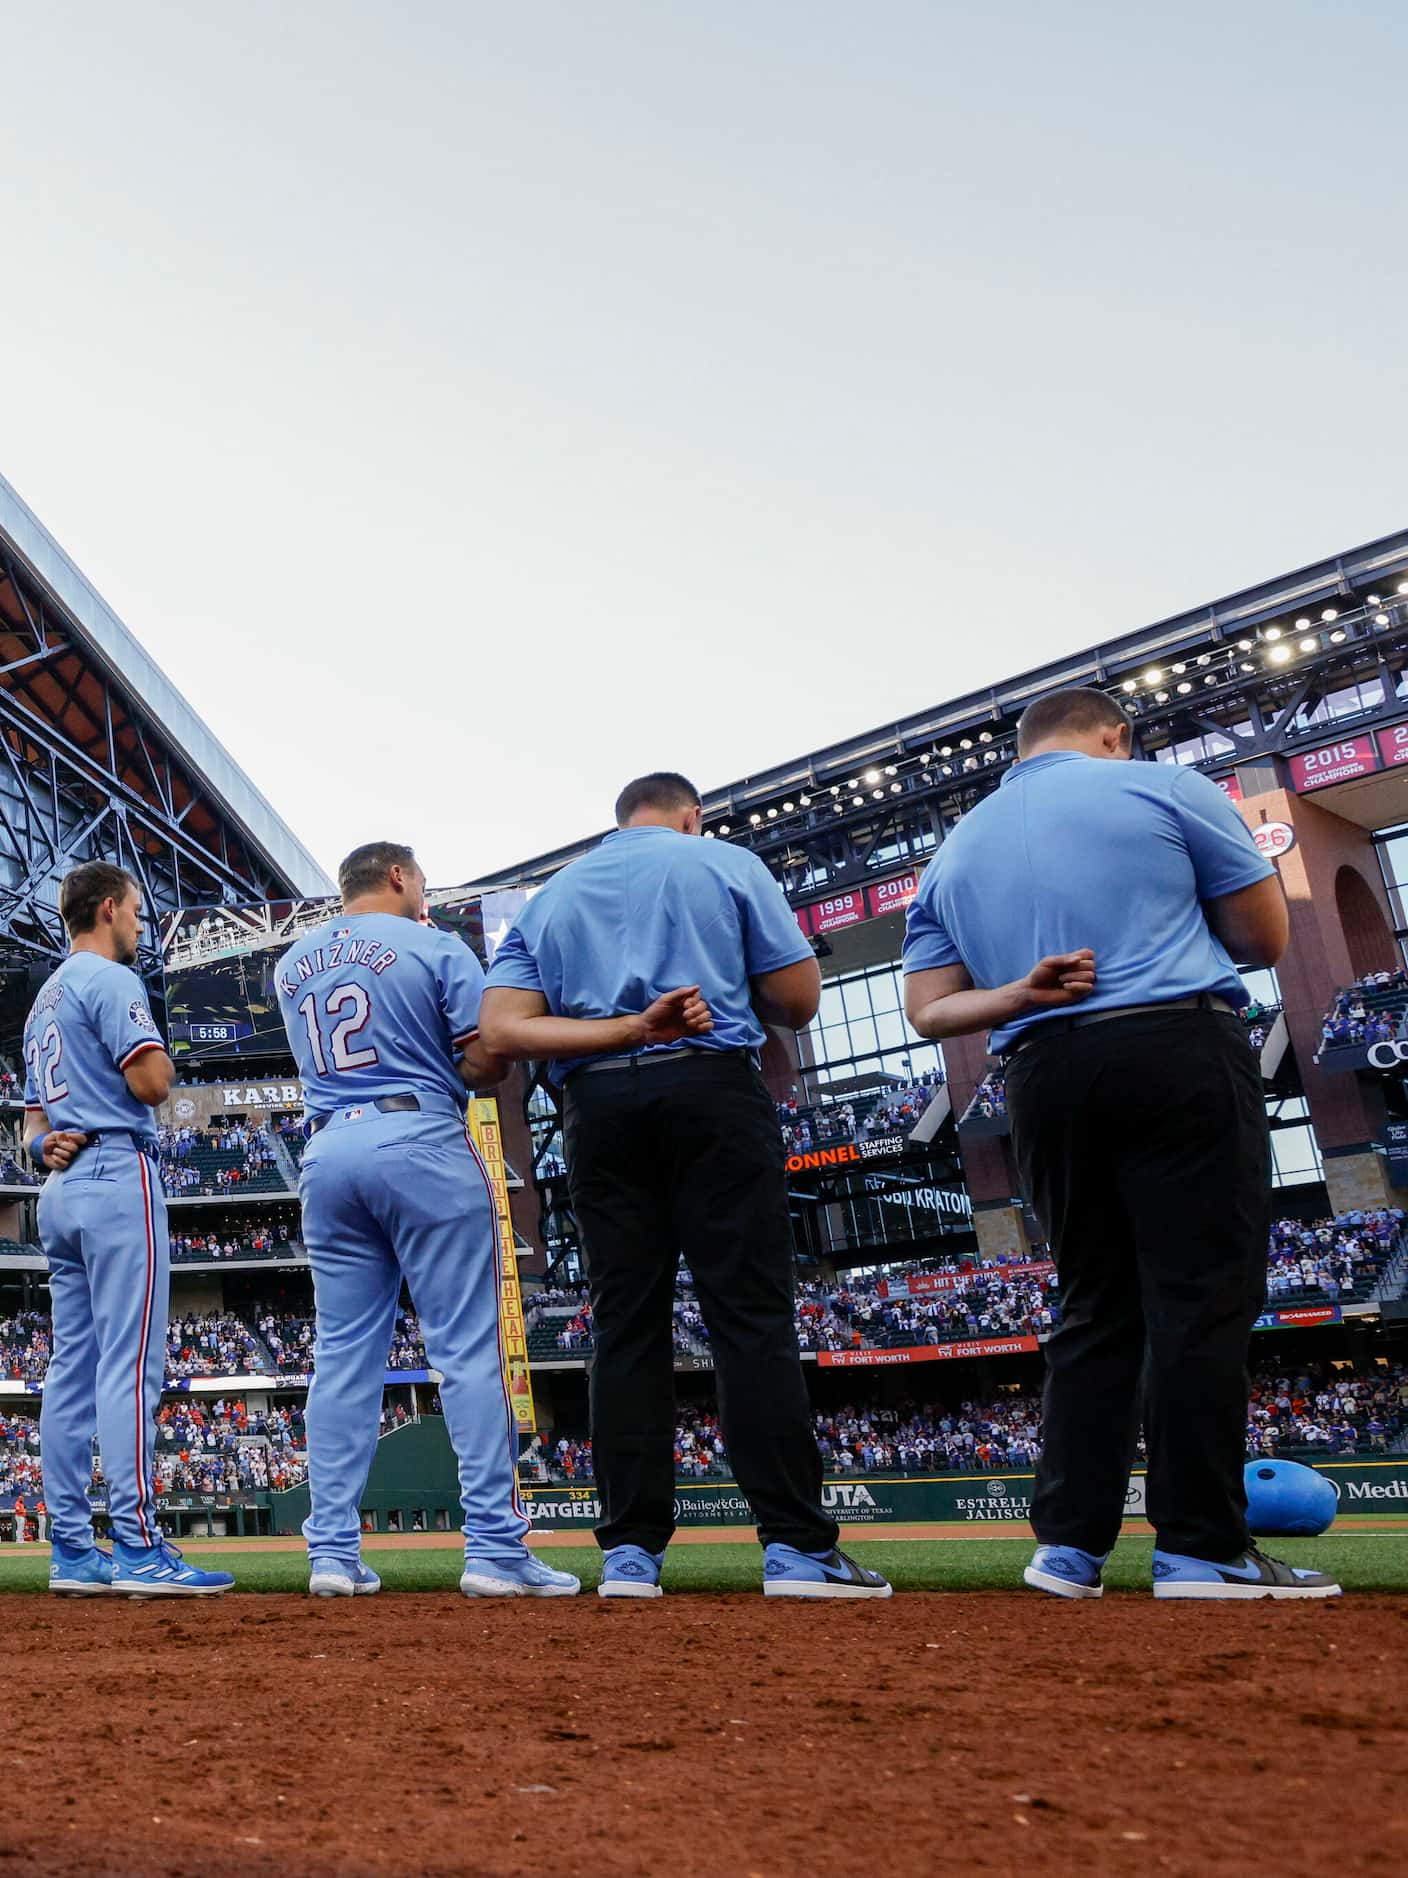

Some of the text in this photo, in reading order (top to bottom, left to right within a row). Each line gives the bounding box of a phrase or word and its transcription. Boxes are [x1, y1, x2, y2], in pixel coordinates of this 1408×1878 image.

[1304, 742, 1356, 771] 2015
[1303, 764, 1365, 787] CHAMPIONS
[1254, 828, 1286, 851] 26
[877, 877, 914, 899] 2010
[819, 895, 854, 916] 1999
[280, 940, 397, 998] KNIZNER
[199, 1027, 228, 1039] 5:58
[298, 981, 380, 1078] 12
[858, 1135, 904, 1151] STAFFING
[785, 1143, 904, 1172] ONNEL SERVICES
[915, 1187, 973, 1215] KRATOM
[503, 1279, 519, 1354] HEAT
[849, 1355, 873, 1364] FORT
[874, 1353, 910, 1363] WORTH
[957, 1347, 982, 1356] FORT
[984, 1343, 1023, 1354] WORTH
[568, 1491, 590, 1500] 334
[821, 1485, 877, 1507] UTA
[1345, 1480, 1408, 1499] Medi
[524, 1501, 602, 1518] EATGEEK
[956, 1497, 1032, 1509] ESTRELL
